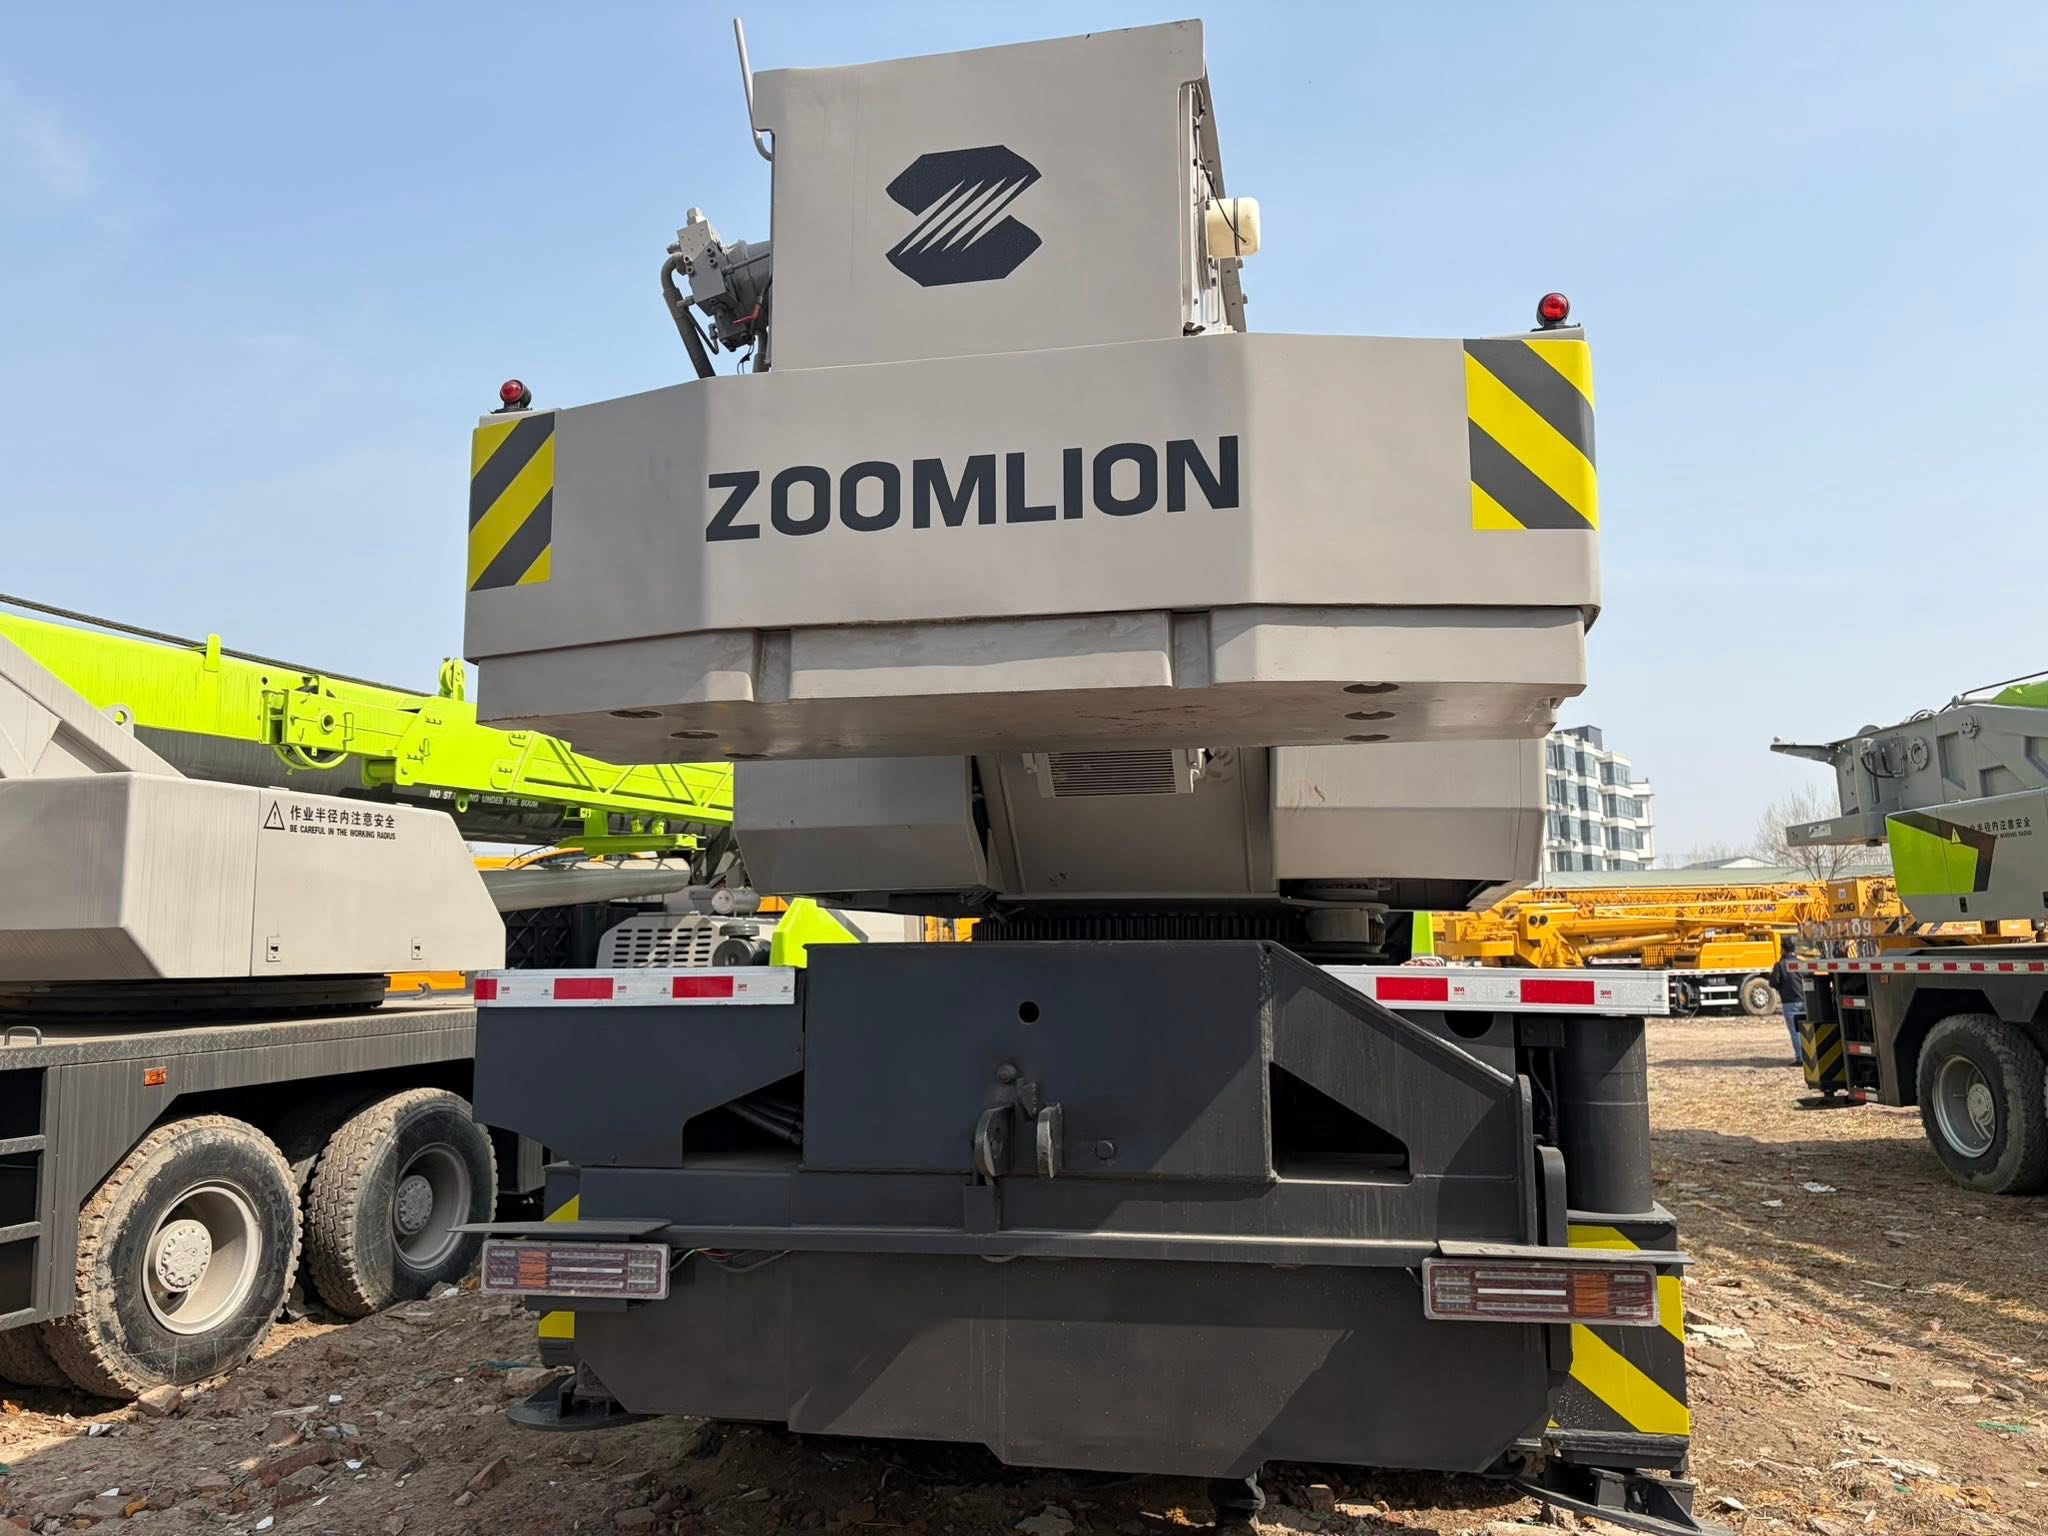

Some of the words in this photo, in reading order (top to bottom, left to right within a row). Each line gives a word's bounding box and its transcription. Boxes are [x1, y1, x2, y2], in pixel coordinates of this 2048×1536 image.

[705, 435, 1240, 542] ZOOMLION
[429, 789, 441, 799] NO
[443, 791, 480, 802] STANG
[482, 796, 505, 805] UNDER
[506, 798, 519, 807] THE
[520, 800, 539, 808] BOOM
[290, 804, 395, 829] 作业半径内注意安全
[289, 824, 298, 833] BE
[300, 825, 326, 835] CAREFUL
[328, 827, 335, 836] IN
[337, 828, 348, 837] THE
[349, 829, 375, 839] WORKING
[377, 831, 396, 840] RADIUS
